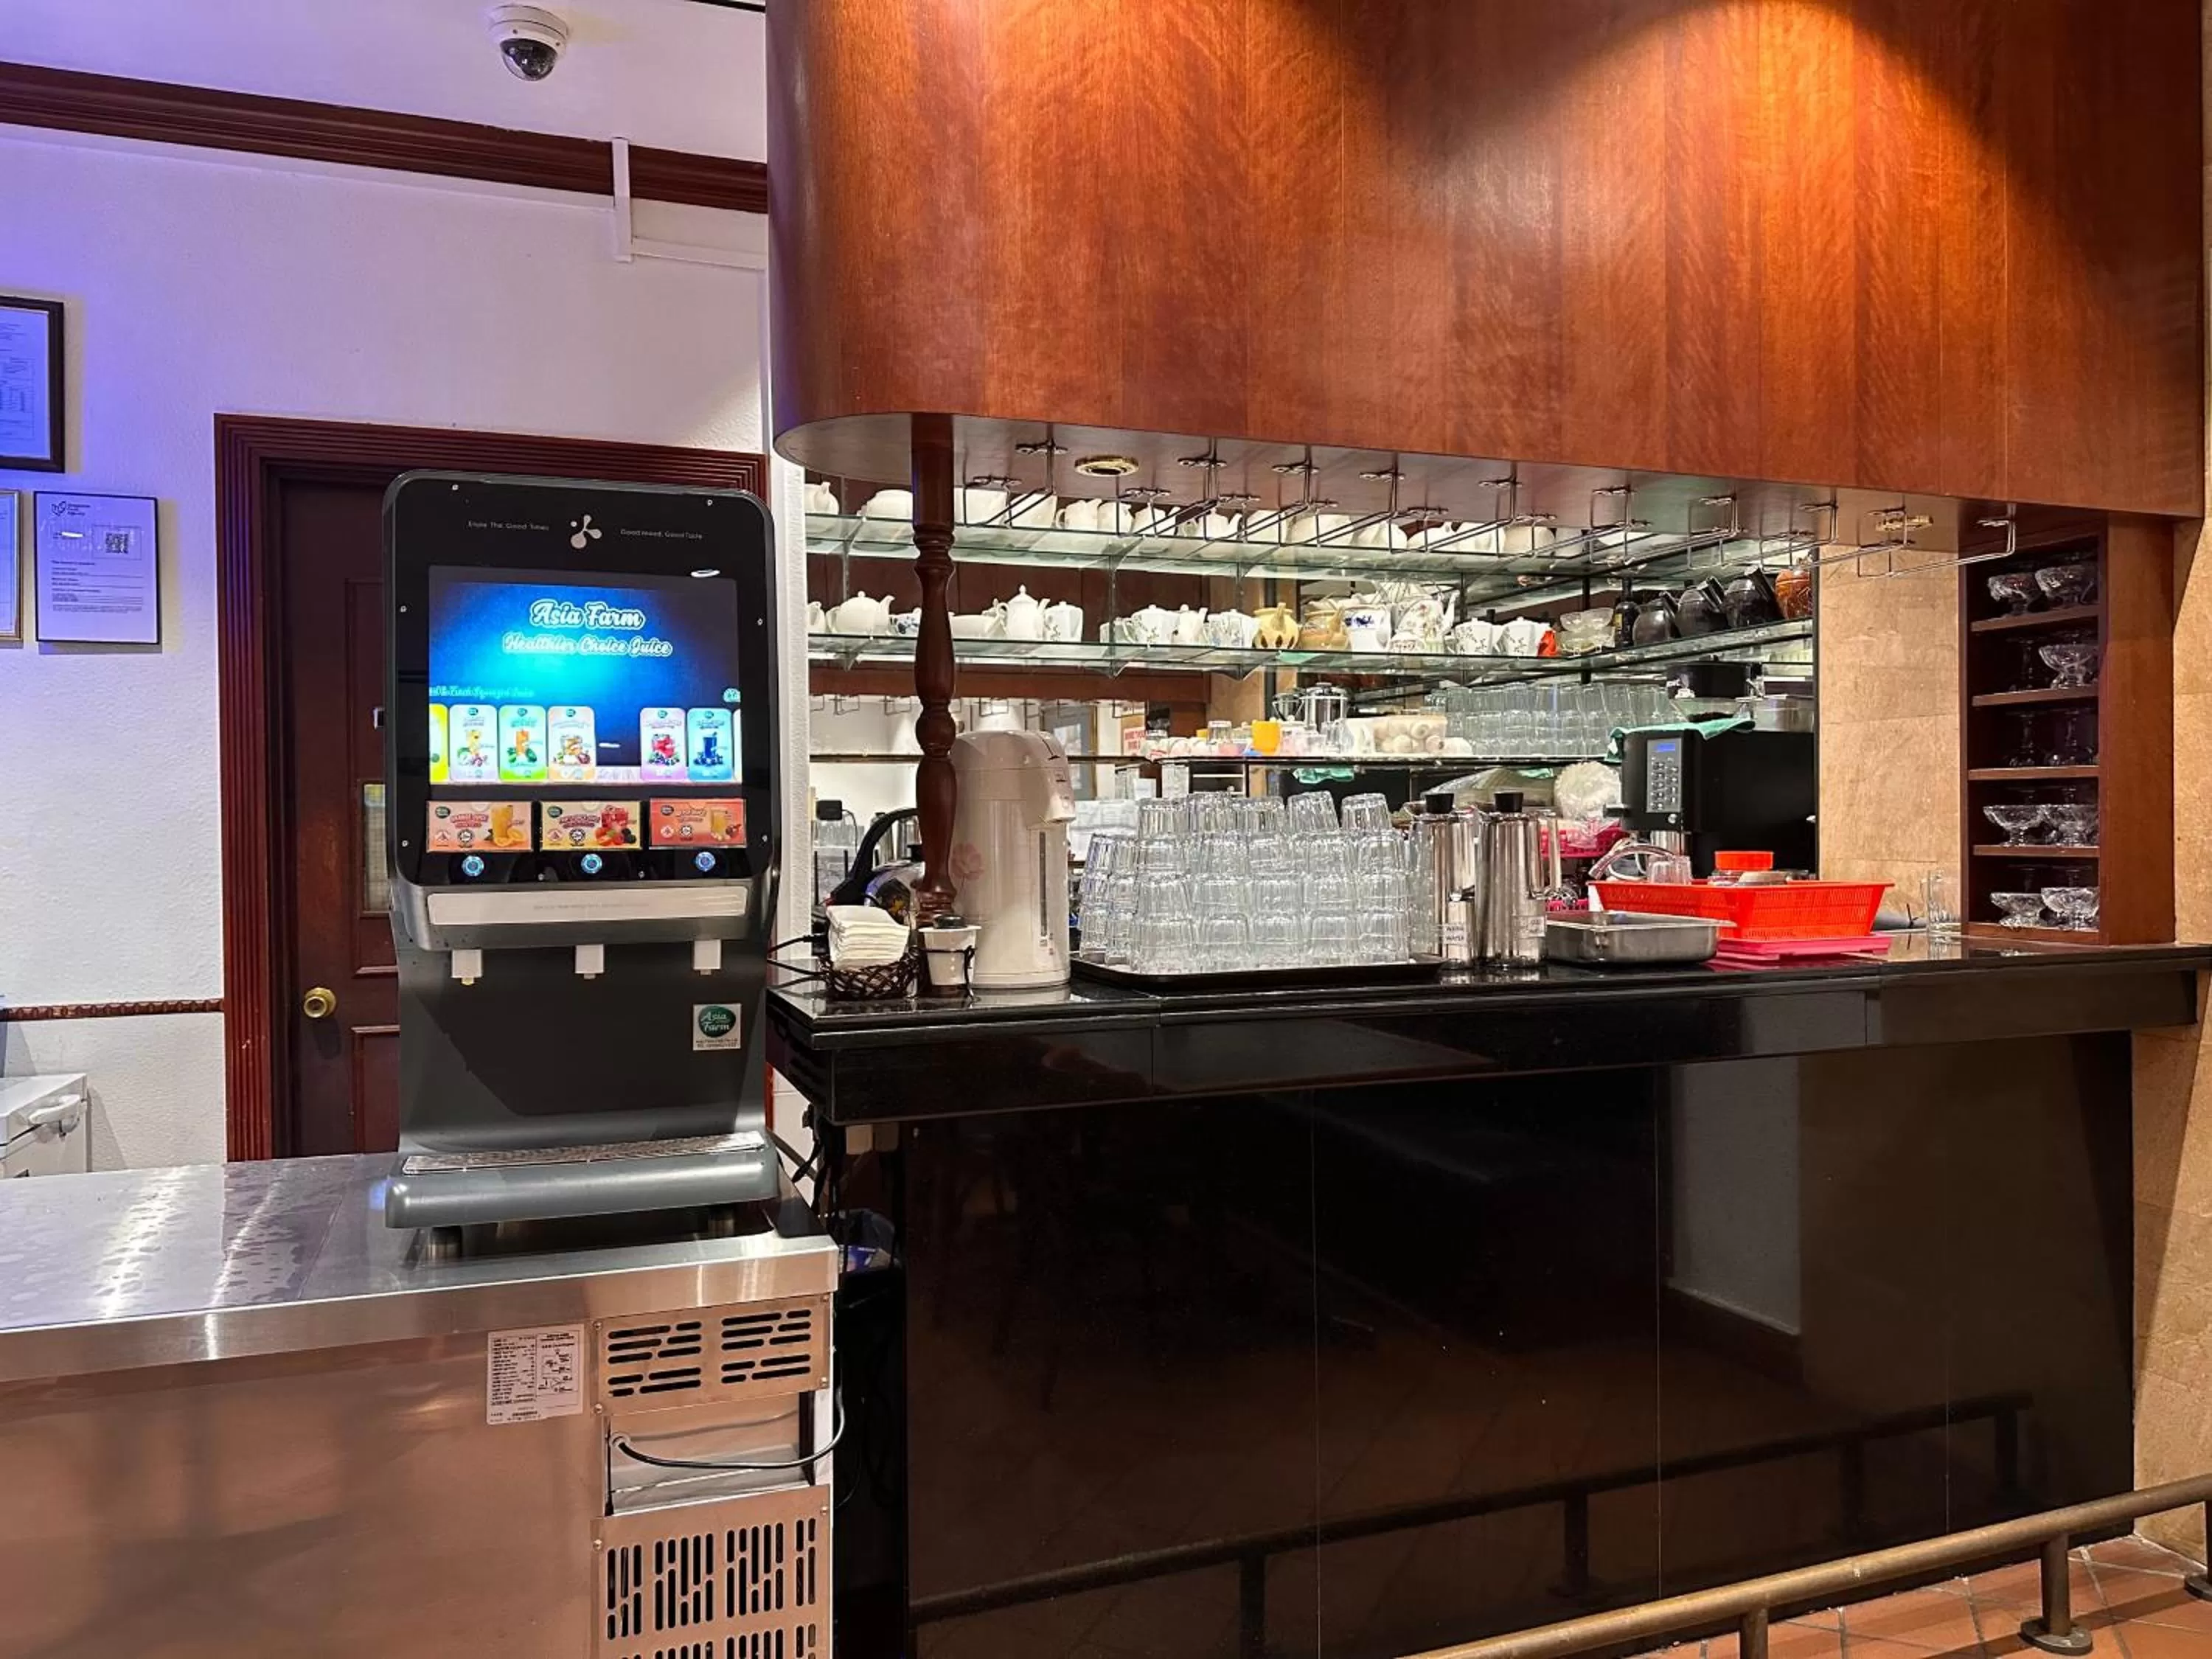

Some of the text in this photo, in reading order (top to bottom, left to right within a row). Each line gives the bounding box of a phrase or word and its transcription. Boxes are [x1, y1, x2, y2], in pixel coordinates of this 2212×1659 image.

[531, 600, 645, 629] Asia Farm
[503, 632, 672, 656] Healthier Choice Juice
[700, 1011, 728, 1022] Asia
[701, 1021, 730, 1032] Farm
